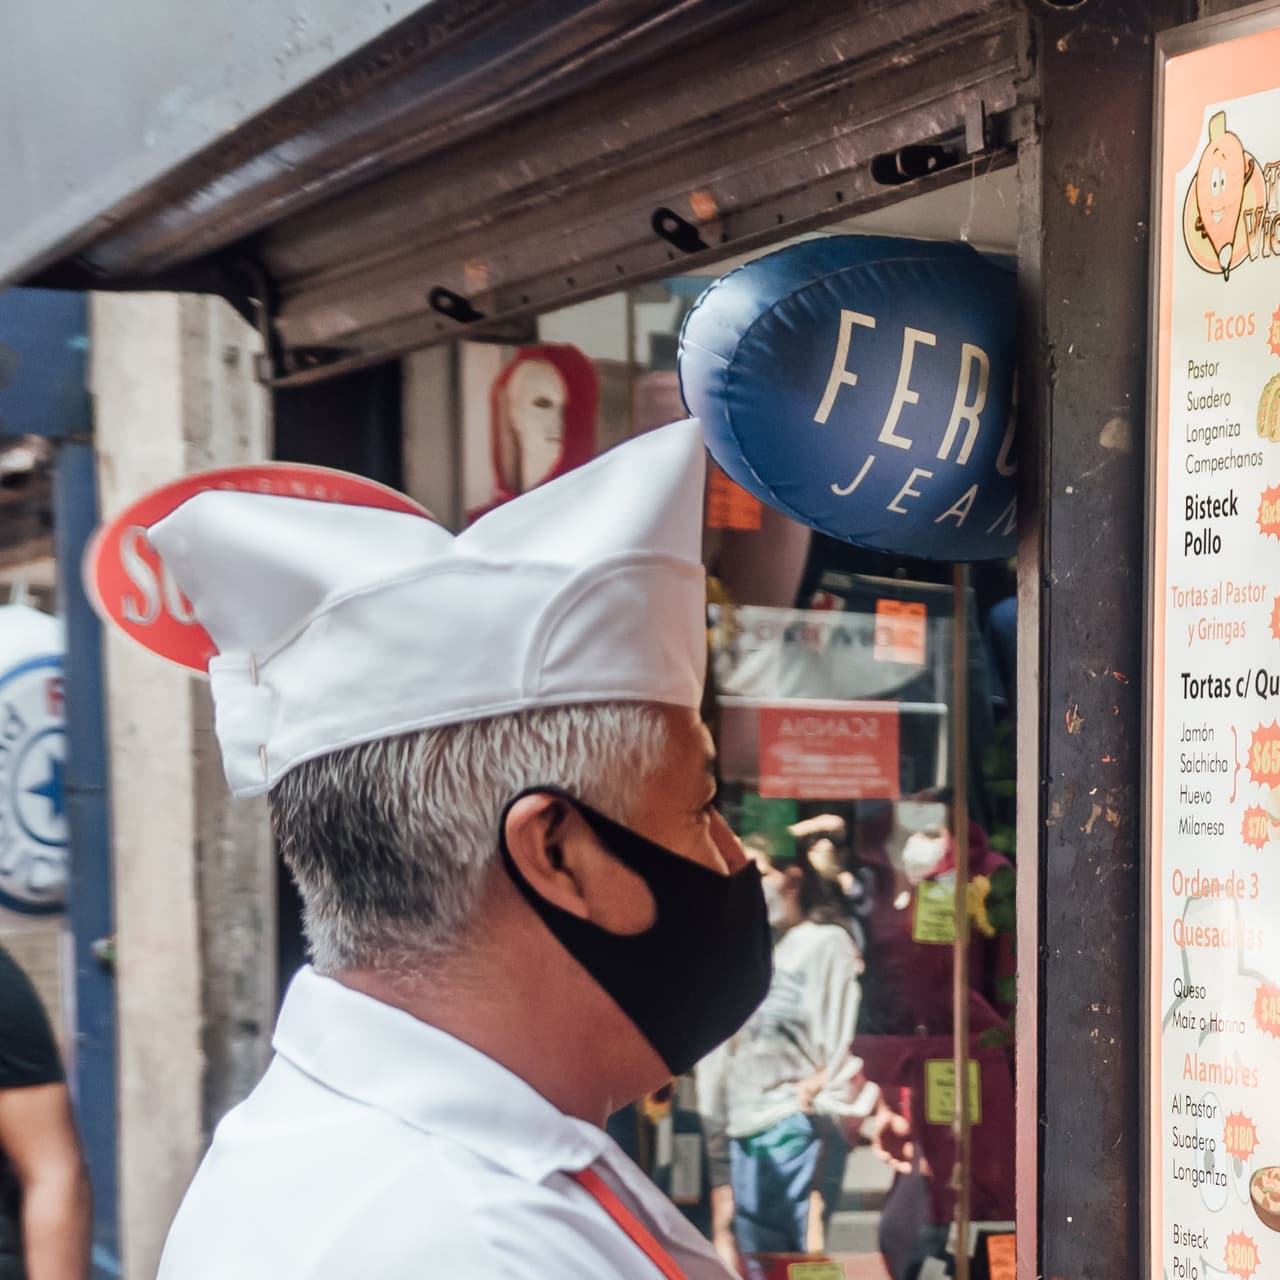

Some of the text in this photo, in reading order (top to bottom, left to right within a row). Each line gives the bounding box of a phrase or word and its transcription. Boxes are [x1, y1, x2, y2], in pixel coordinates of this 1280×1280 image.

[1204, 311, 1256, 343] Tacos
[1188, 359, 1220, 380] Pastor
[1187, 387, 1232, 412] Suadero
[1186, 418, 1241, 446] Longaniza
[1185, 449, 1263, 476] Campechanos
[1185, 489, 1238, 521] Bisteck
[1184, 528, 1222, 557] Pollo
[1171, 581, 1267, 609] Tortas al Pastor
[1188, 616, 1246, 647] y Gringas
[1181, 672, 1232, 700] Tortas
[1236, 668, 1252, 699] c/
[1180, 721, 1215, 742] Jamón
[1180, 752, 1228, 774] Salchicha
[1180, 783, 1212, 805] Huevo
[1178, 816, 1225, 836] Milanesa
[1172, 867, 1259, 899] Orden de 3
[1173, 977, 1206, 999] Queso
[1172, 1009, 1196, 1030] Maíz
[1199, 1017, 1206, 1031] o
[1183, 1052, 1259, 1089] Alambres
[1172, 1093, 1217, 1119] Al Pastor
[1172, 1126, 1216, 1153] Suadero
[1173, 1158, 1228, 1188] Longaniza
[1173, 1223, 1209, 1250] Bisteck
[1173, 1256, 1198, 1280] Pollo
